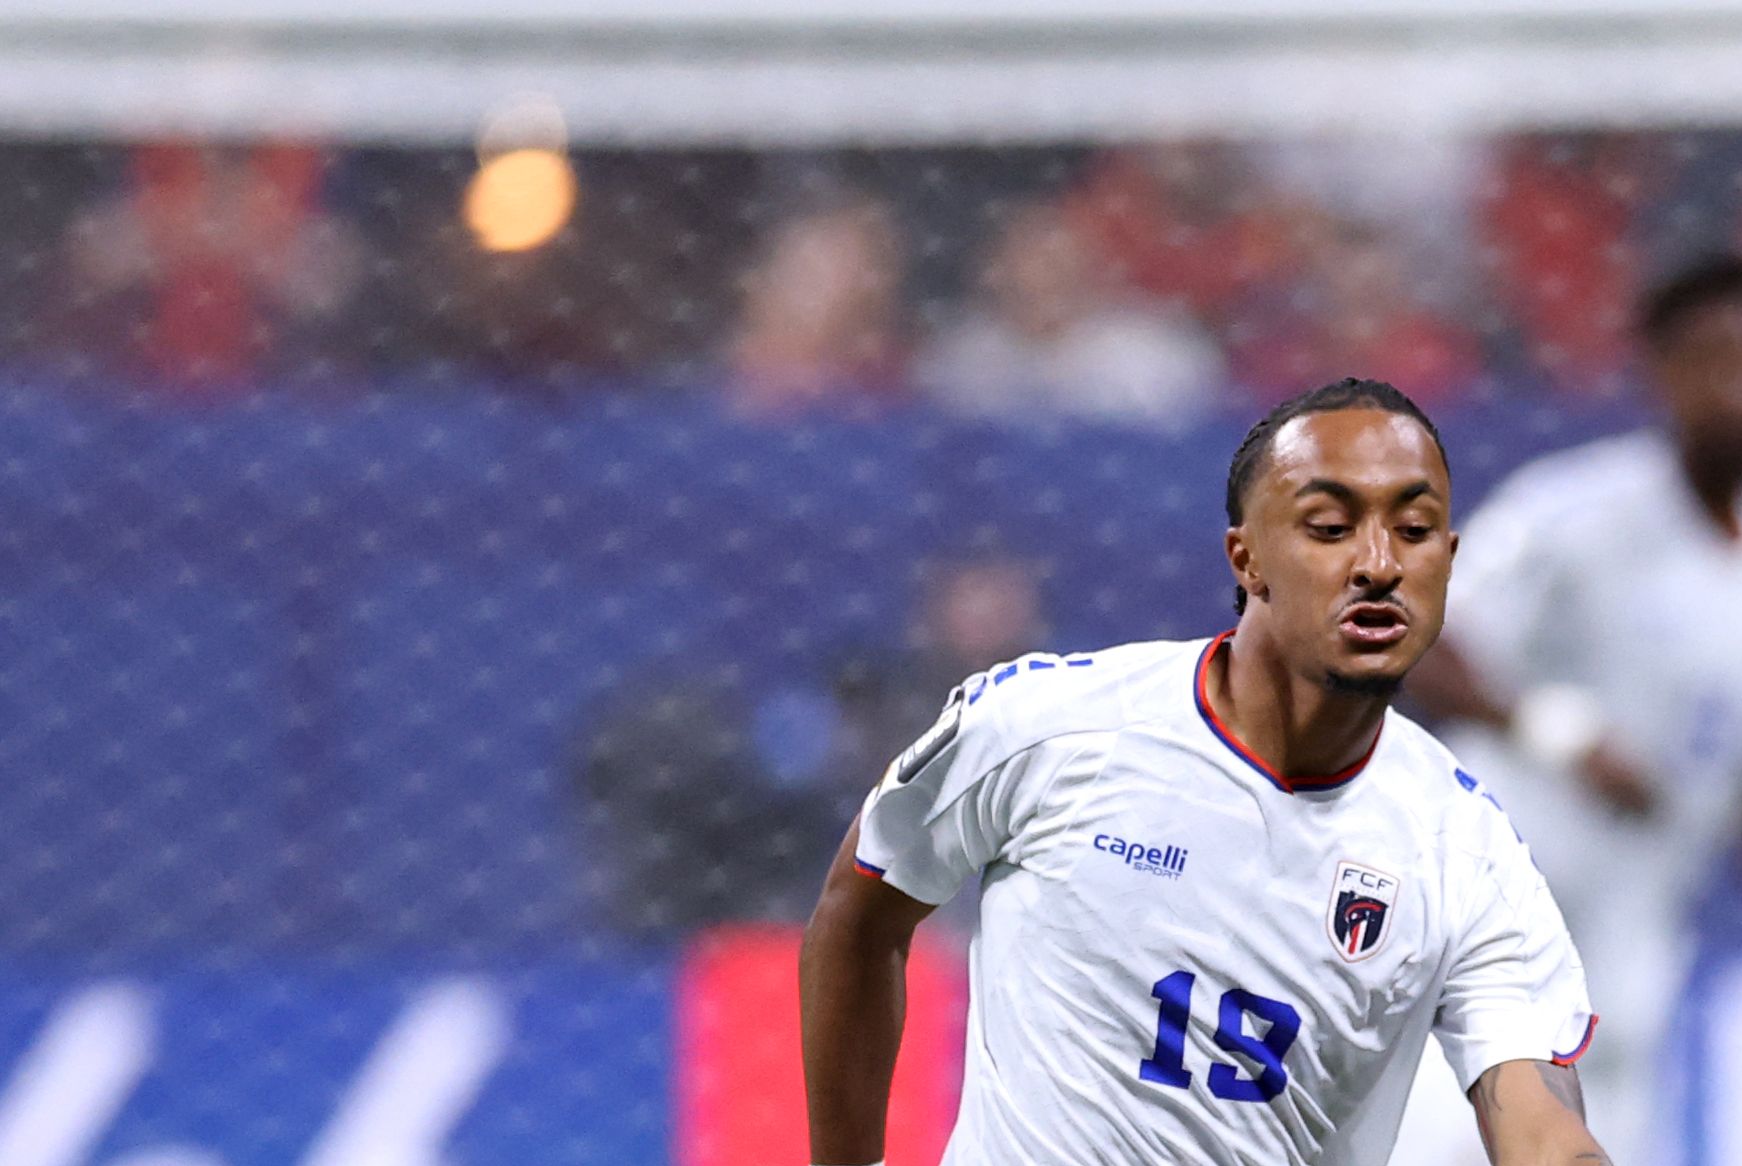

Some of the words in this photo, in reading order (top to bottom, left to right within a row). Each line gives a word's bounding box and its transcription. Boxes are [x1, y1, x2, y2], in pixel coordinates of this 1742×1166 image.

[1093, 833, 1188, 872] capelli
[1133, 861, 1181, 881] SPORT
[1343, 868, 1394, 890] FCF
[1139, 969, 1301, 1102] 19
